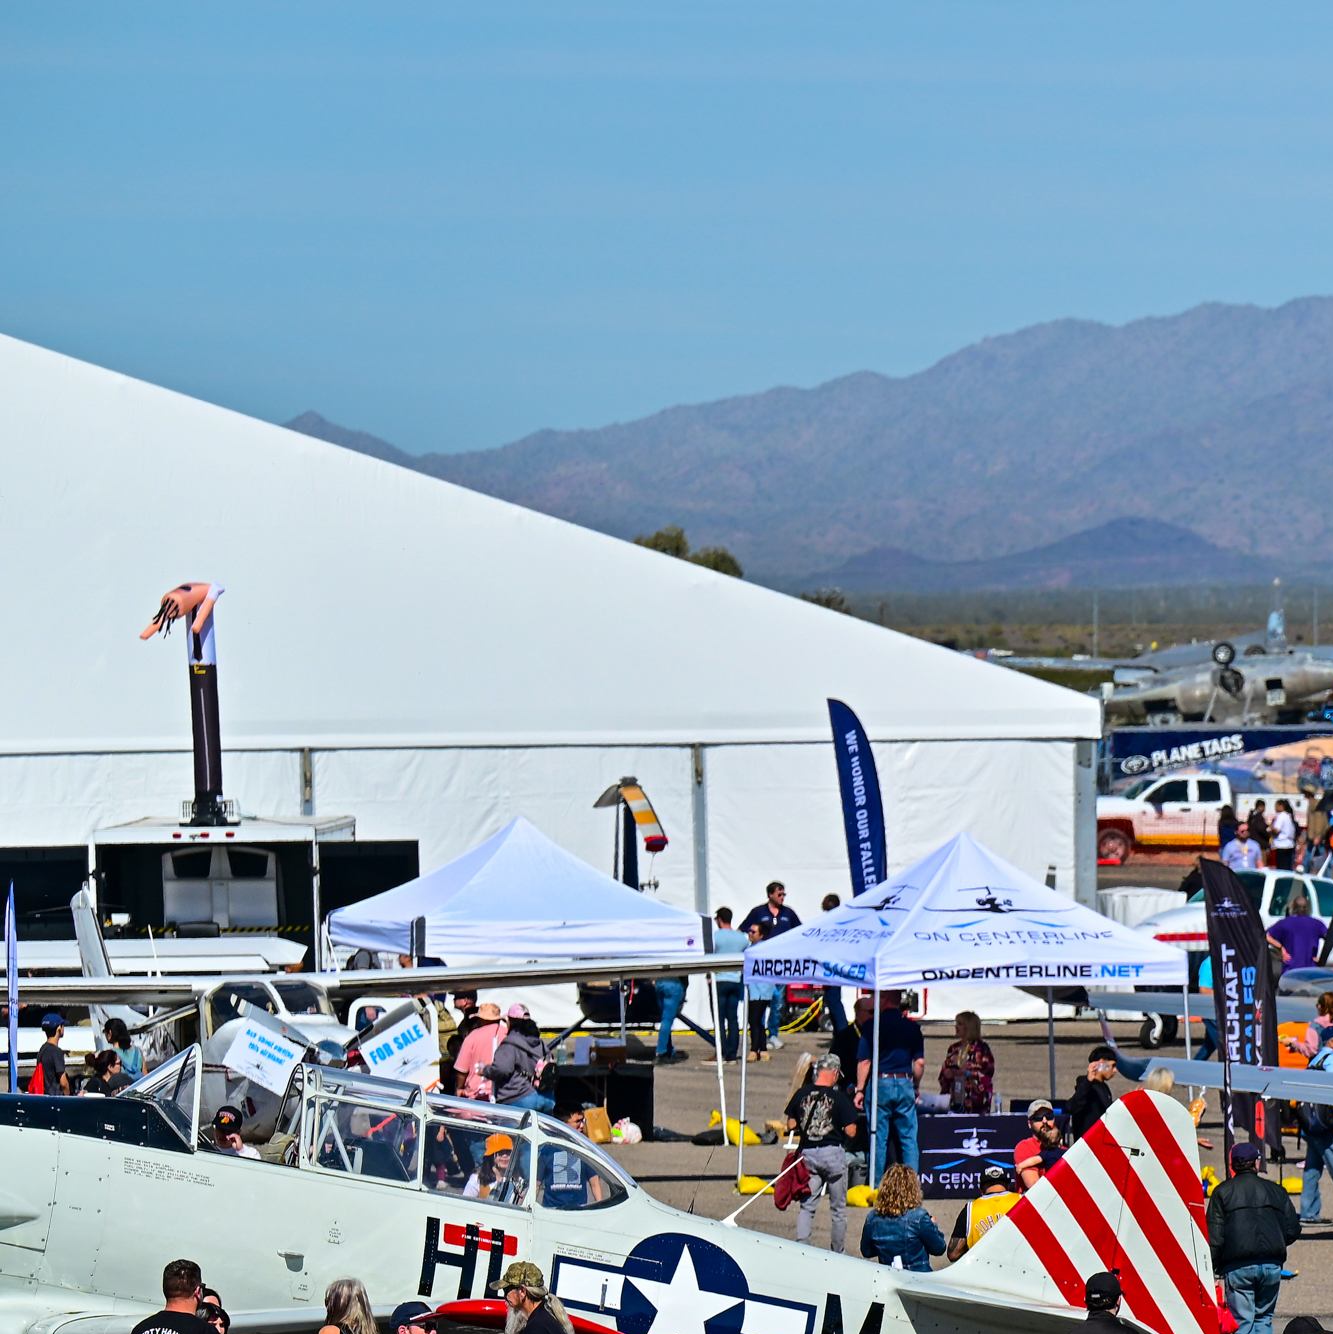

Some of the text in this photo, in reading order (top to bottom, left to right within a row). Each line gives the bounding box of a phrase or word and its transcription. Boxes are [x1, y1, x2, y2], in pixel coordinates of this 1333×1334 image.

[844, 729, 859, 755] WE
[851, 755, 867, 807] HONOR
[856, 809, 870, 840] OUR
[914, 931, 950, 942] ON
[752, 959, 819, 977] AIRCRAFT
[921, 964, 1145, 981] ONCENTERLINE.NET
[369, 1023, 425, 1067] FOR SALE
